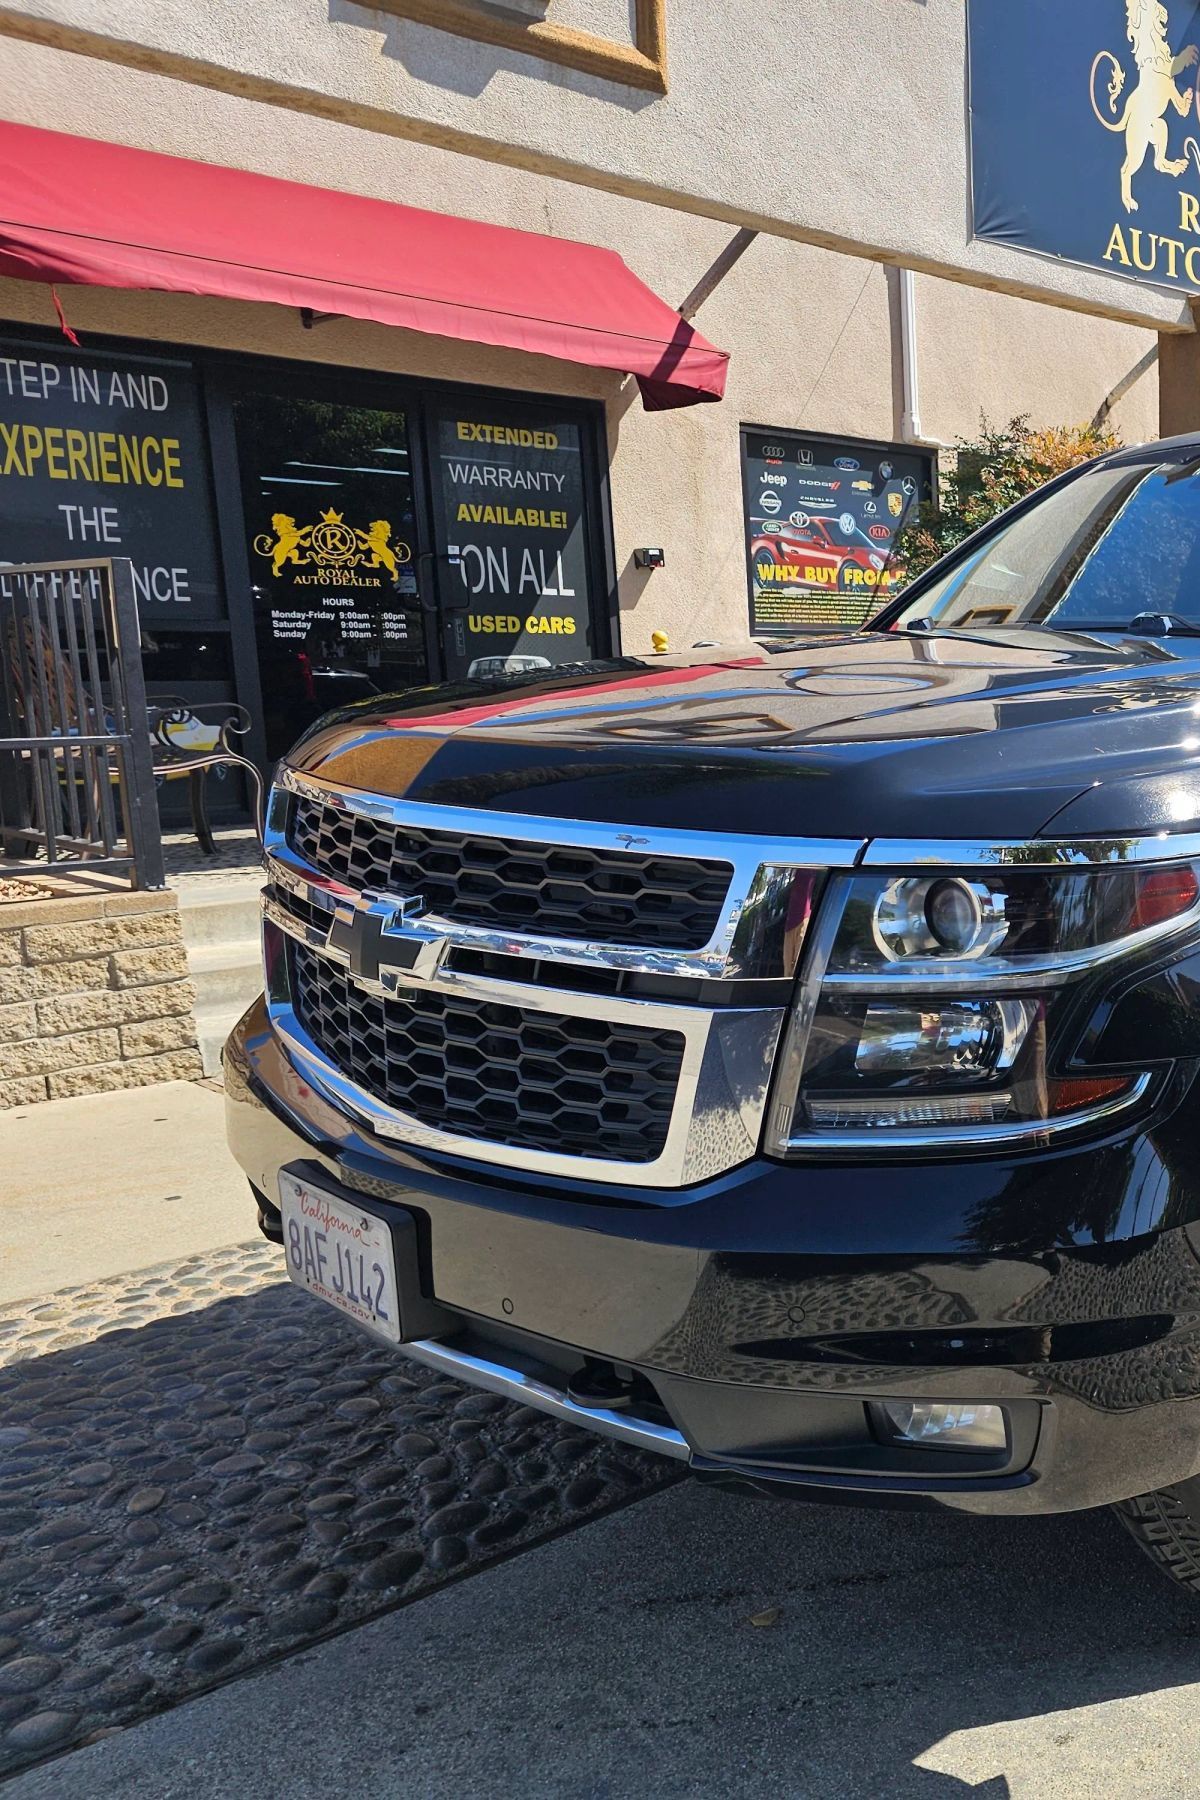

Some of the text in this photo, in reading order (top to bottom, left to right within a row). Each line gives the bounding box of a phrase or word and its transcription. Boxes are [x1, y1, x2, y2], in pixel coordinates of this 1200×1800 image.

[69, 366, 101, 405] IN
[108, 371, 169, 412] AND
[456, 421, 558, 450] EXTENDED
[0, 422, 184, 488] XPERIENCE
[447, 462, 566, 493] WARRANTY
[760, 471, 788, 487] Jeep
[58, 504, 122, 543] THE
[457, 503, 568, 529] AVAILABLE!
[293, 576, 382, 587] AUTO DEALER
[317, 568, 358, 579] ROYAL
[460, 544, 576, 597] ON ALL
[756, 563, 800, 582] WHY
[804, 566, 838, 584] BUY
[843, 568, 891, 586] FROM
[322, 597, 355, 607] HOURS
[271, 610, 336, 621] Monday-Friday
[339, 612, 370, 620] 9:00am
[272, 620, 312, 630] Saturday
[340, 621, 371, 629] 9:00am
[468, 614, 577, 635] USED CARS
[273, 629, 307, 639] Sunday
[341, 630, 372, 638] 9:00am
[300, 1190, 371, 1247] California
[288, 1218, 389, 1321] 8AFJ142
